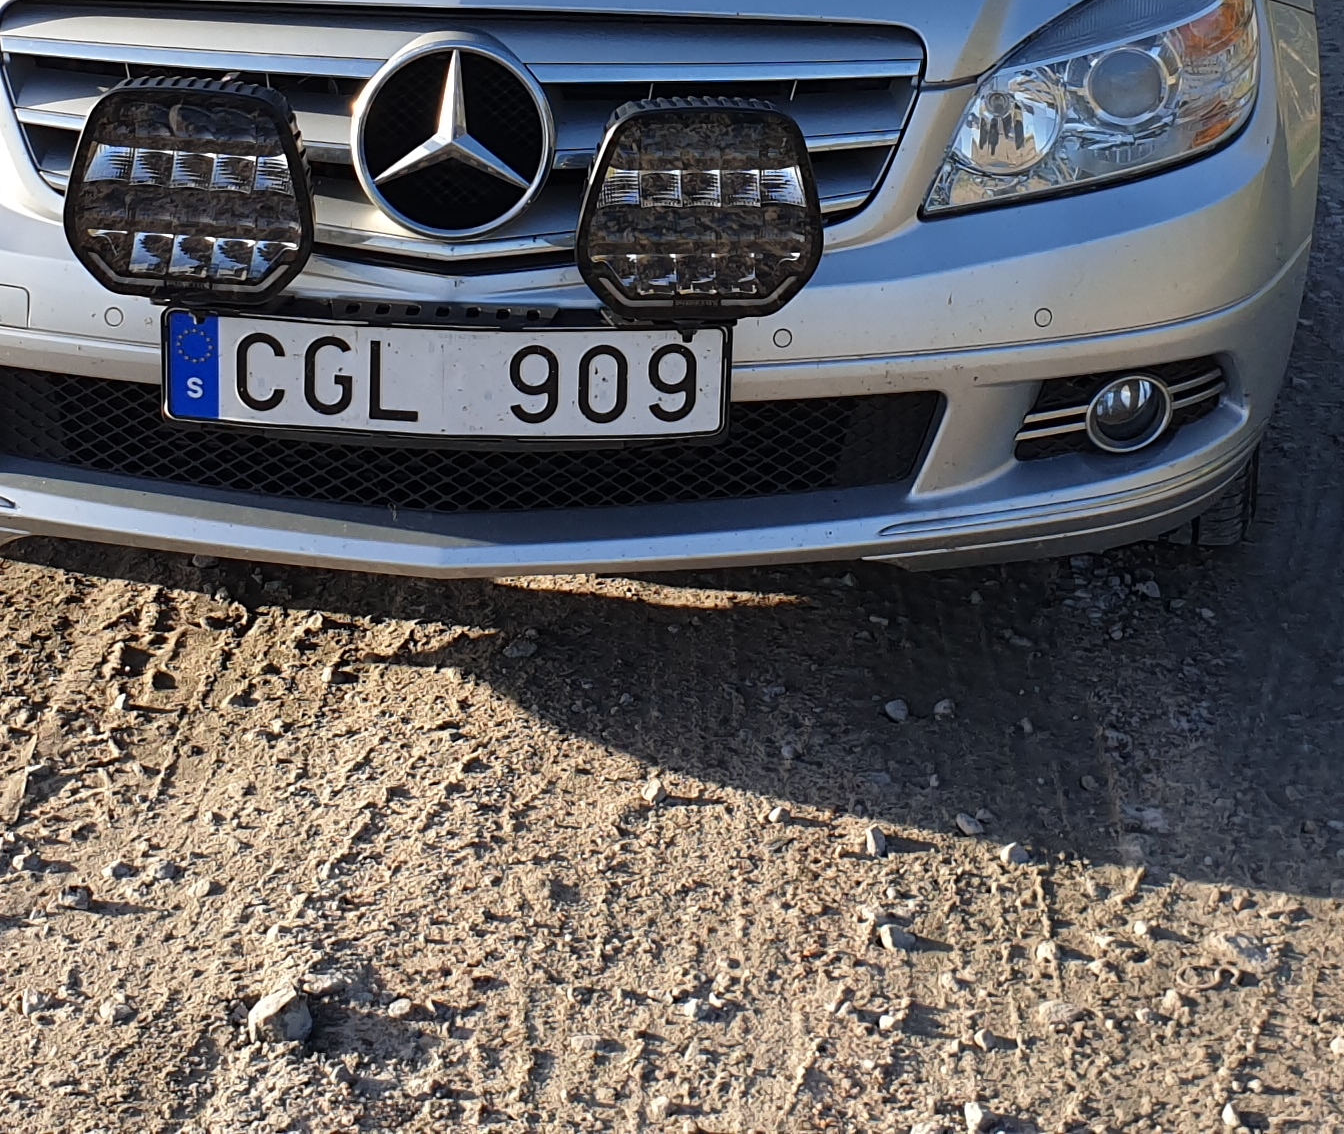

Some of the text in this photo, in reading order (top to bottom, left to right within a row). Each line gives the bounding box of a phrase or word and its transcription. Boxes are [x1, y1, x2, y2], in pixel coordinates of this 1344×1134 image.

[186, 376, 204, 400] S
[236, 332, 697, 423] CGL 909
